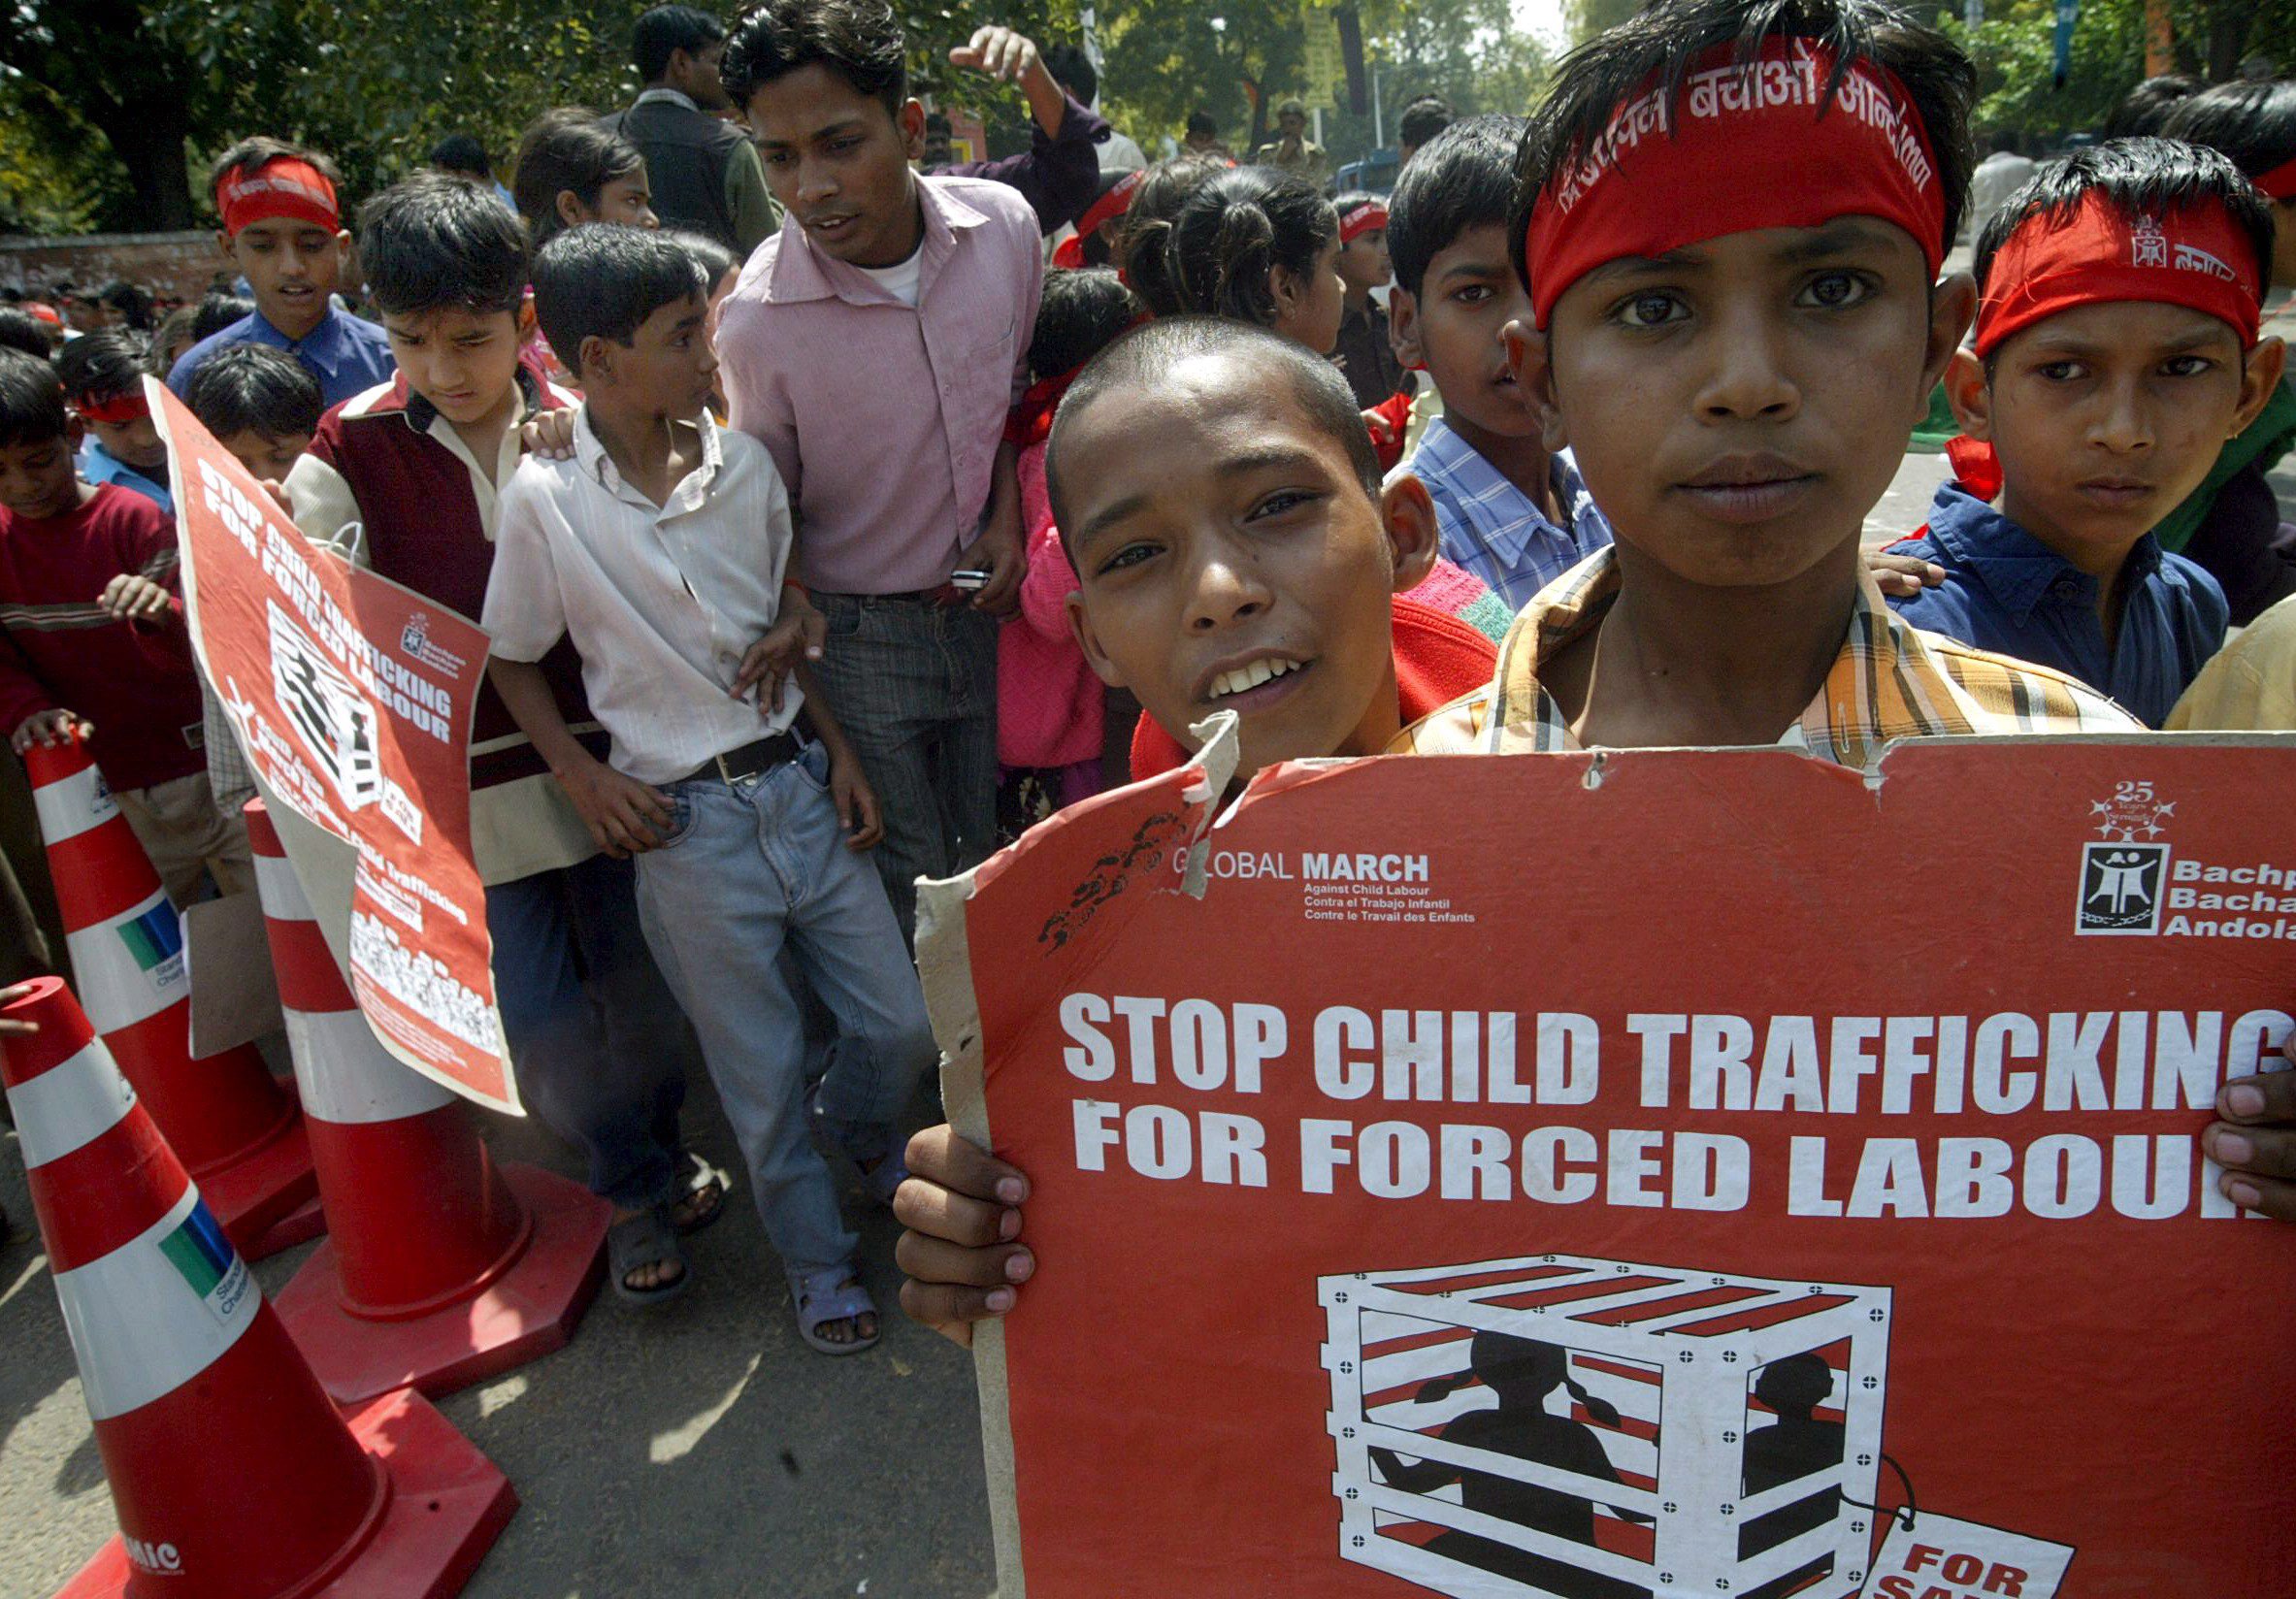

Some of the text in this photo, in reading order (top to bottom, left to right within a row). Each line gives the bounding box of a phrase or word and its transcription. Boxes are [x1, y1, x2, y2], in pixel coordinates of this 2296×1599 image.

[1688, 36, 1817, 117] बचाओ
[197, 457, 263, 530] STOP
[267, 522, 322, 605] CHILD
[323, 590, 452, 719] TRAFFICKING
[203, 485, 257, 559] FOR
[262, 546, 346, 664] FORCED
[348, 650, 450, 745] LABOUR
[2114, 780, 2153, 802] 25
[1172, 846, 1428, 882] GOBAL MARCH
[1304, 883, 1429, 896] Against Child Labour
[1304, 896, 1451, 910] Contra el Trabajo Infantil
[2169, 887, 2296, 914] Bacha
[1304, 909, 1475, 923] Contre le Travail des Enfants
[1060, 992, 1288, 1093] STOP
[1313, 1005, 1599, 1105] CHILD
[1072, 1098, 1268, 1188] FOR
[1300, 1118, 1751, 1211] FORCED
[1903, 1543, 2028, 1599] FOR
